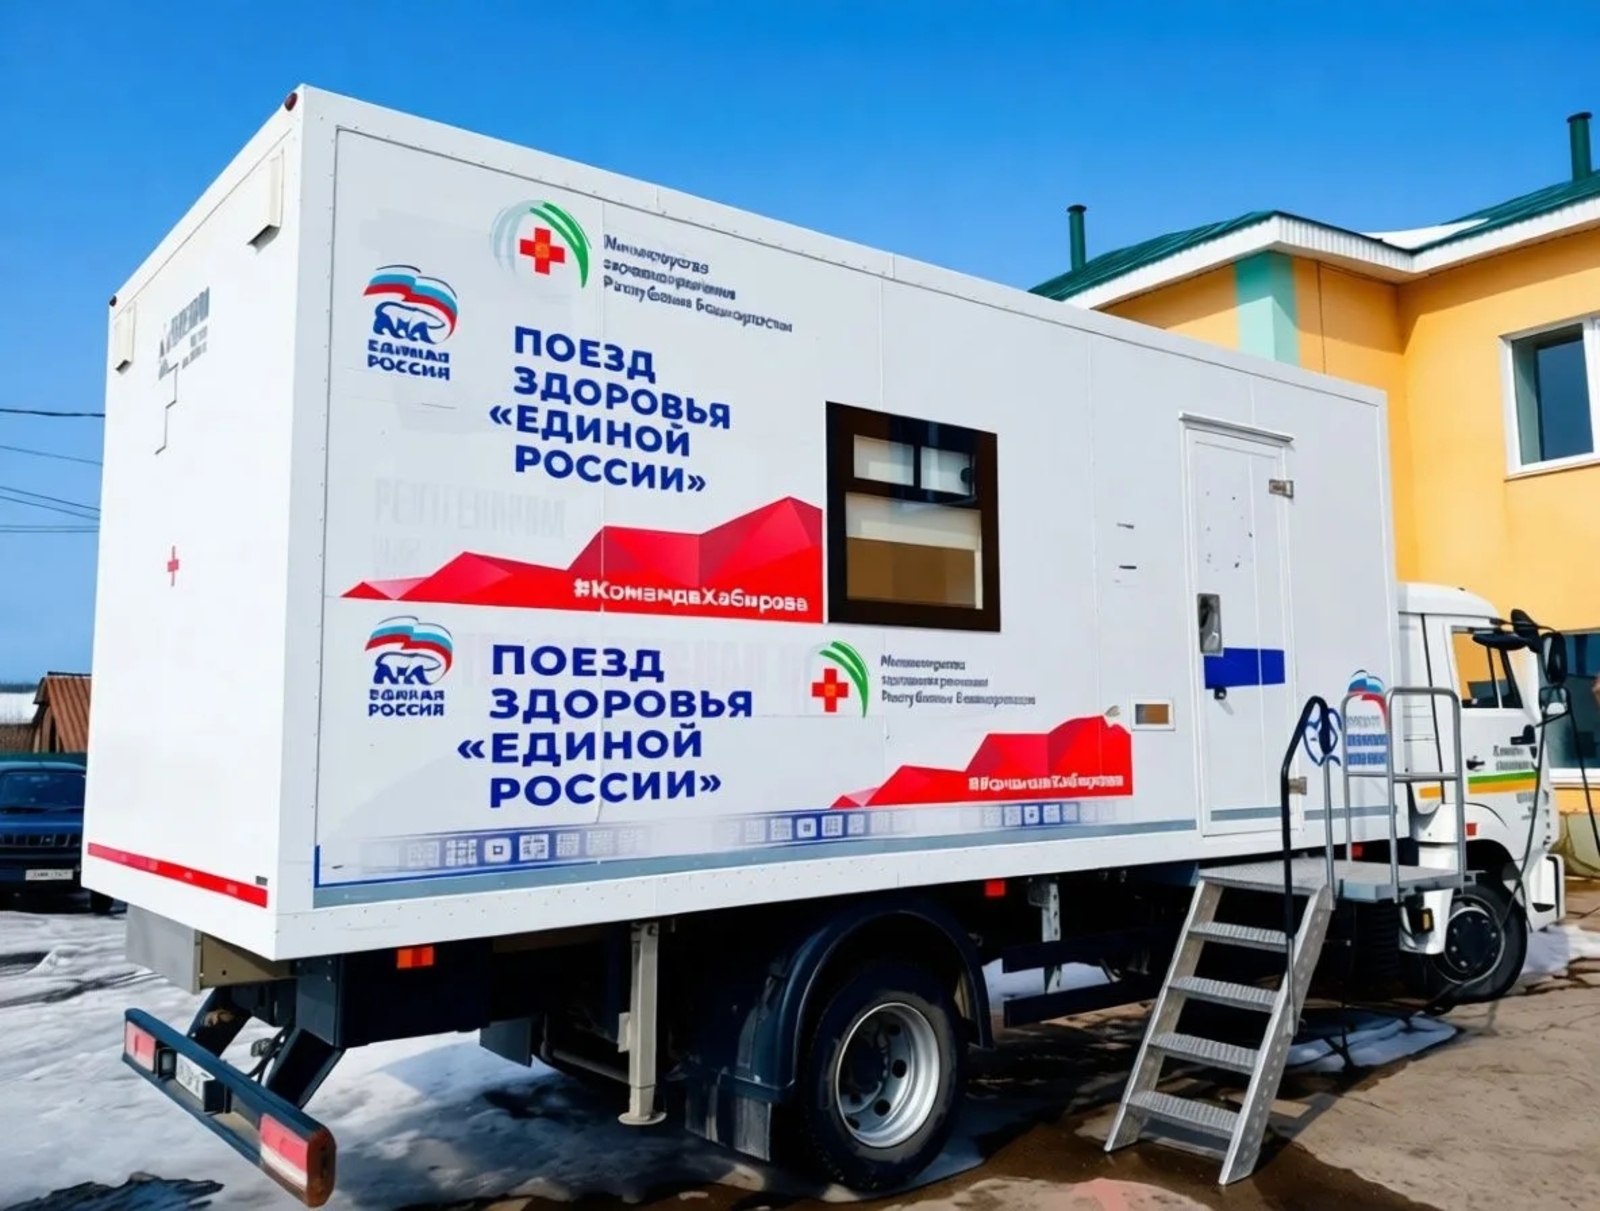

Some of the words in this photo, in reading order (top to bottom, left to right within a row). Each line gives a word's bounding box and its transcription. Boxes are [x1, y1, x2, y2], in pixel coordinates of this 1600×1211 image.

[367, 353, 450, 380] РОССИЯ
[514, 325, 656, 384] ПОЕЗД
[513, 365, 730, 430] ЗДОРОВЬЯ
[489, 404, 690, 457] «ЕДИНОЙ
[515, 444, 706, 493] РОССИИ»
[492, 644, 665, 683] ПОЕЗД
[368, 703, 444, 717] РОССИЯ
[489, 687, 753, 725] ЗДОРОВЬЯ
[457, 723, 702, 767] «ЕДИНОЙ
[490, 770, 721, 809] РОССИИ»
